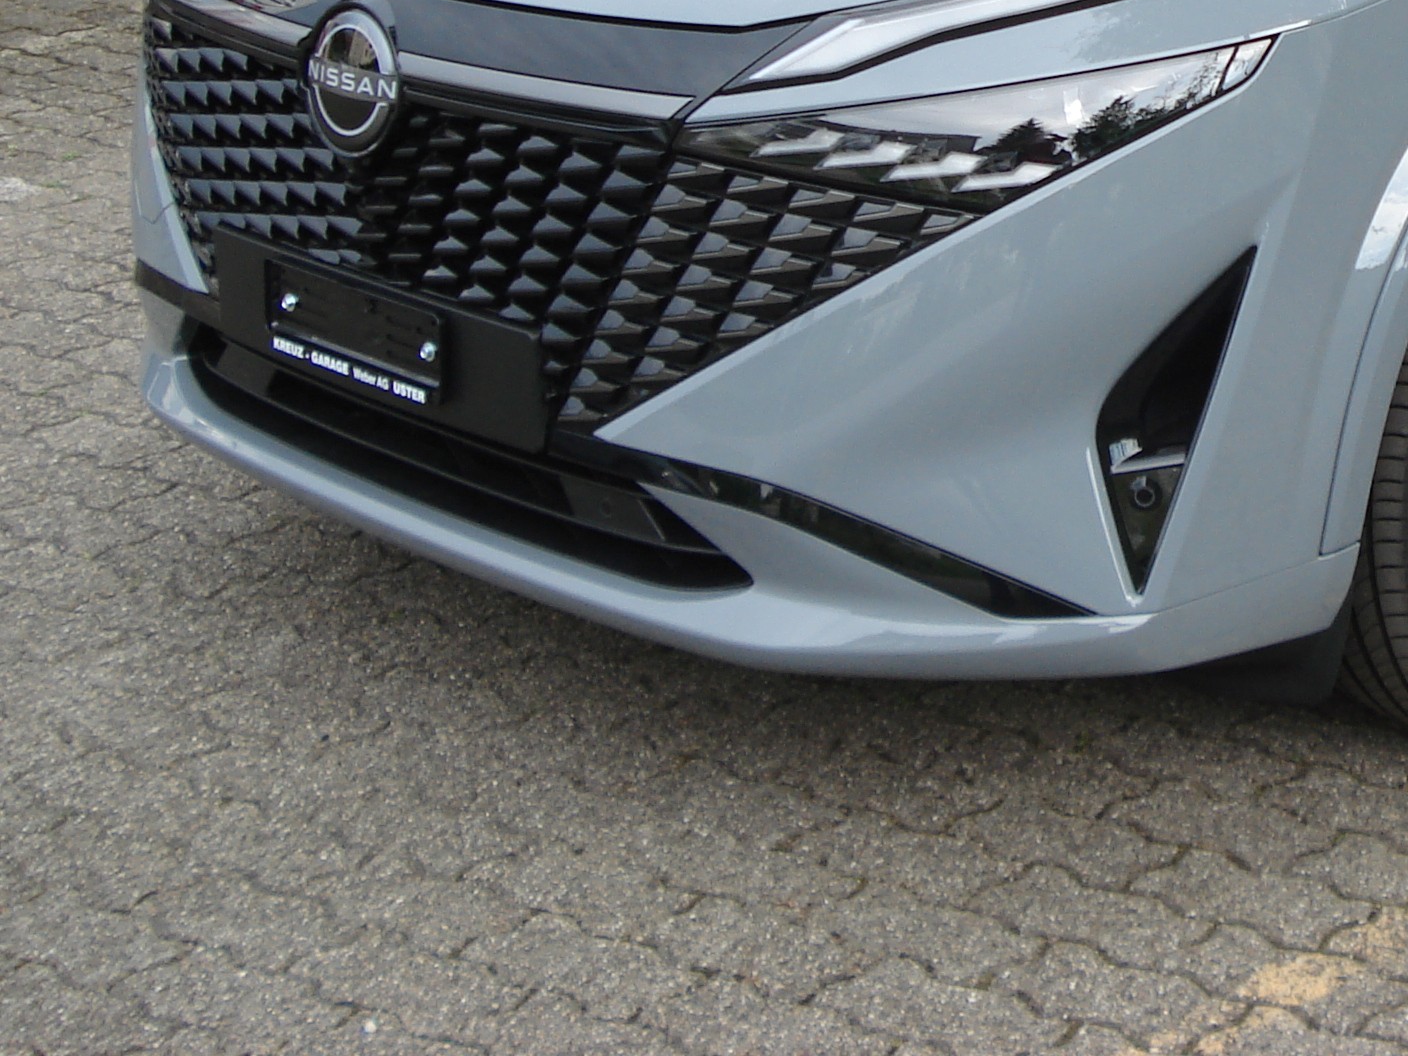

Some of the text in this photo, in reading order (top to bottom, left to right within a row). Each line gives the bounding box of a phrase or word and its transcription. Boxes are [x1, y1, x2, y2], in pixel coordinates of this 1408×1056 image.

[308, 59, 397, 99] NISSAN
[273, 336, 304, 359] KREUZ
[311, 351, 349, 375] GARAGE
[352, 366, 376, 385] Weber
[377, 375, 389, 391] AG
[393, 380, 425, 404] USTER
